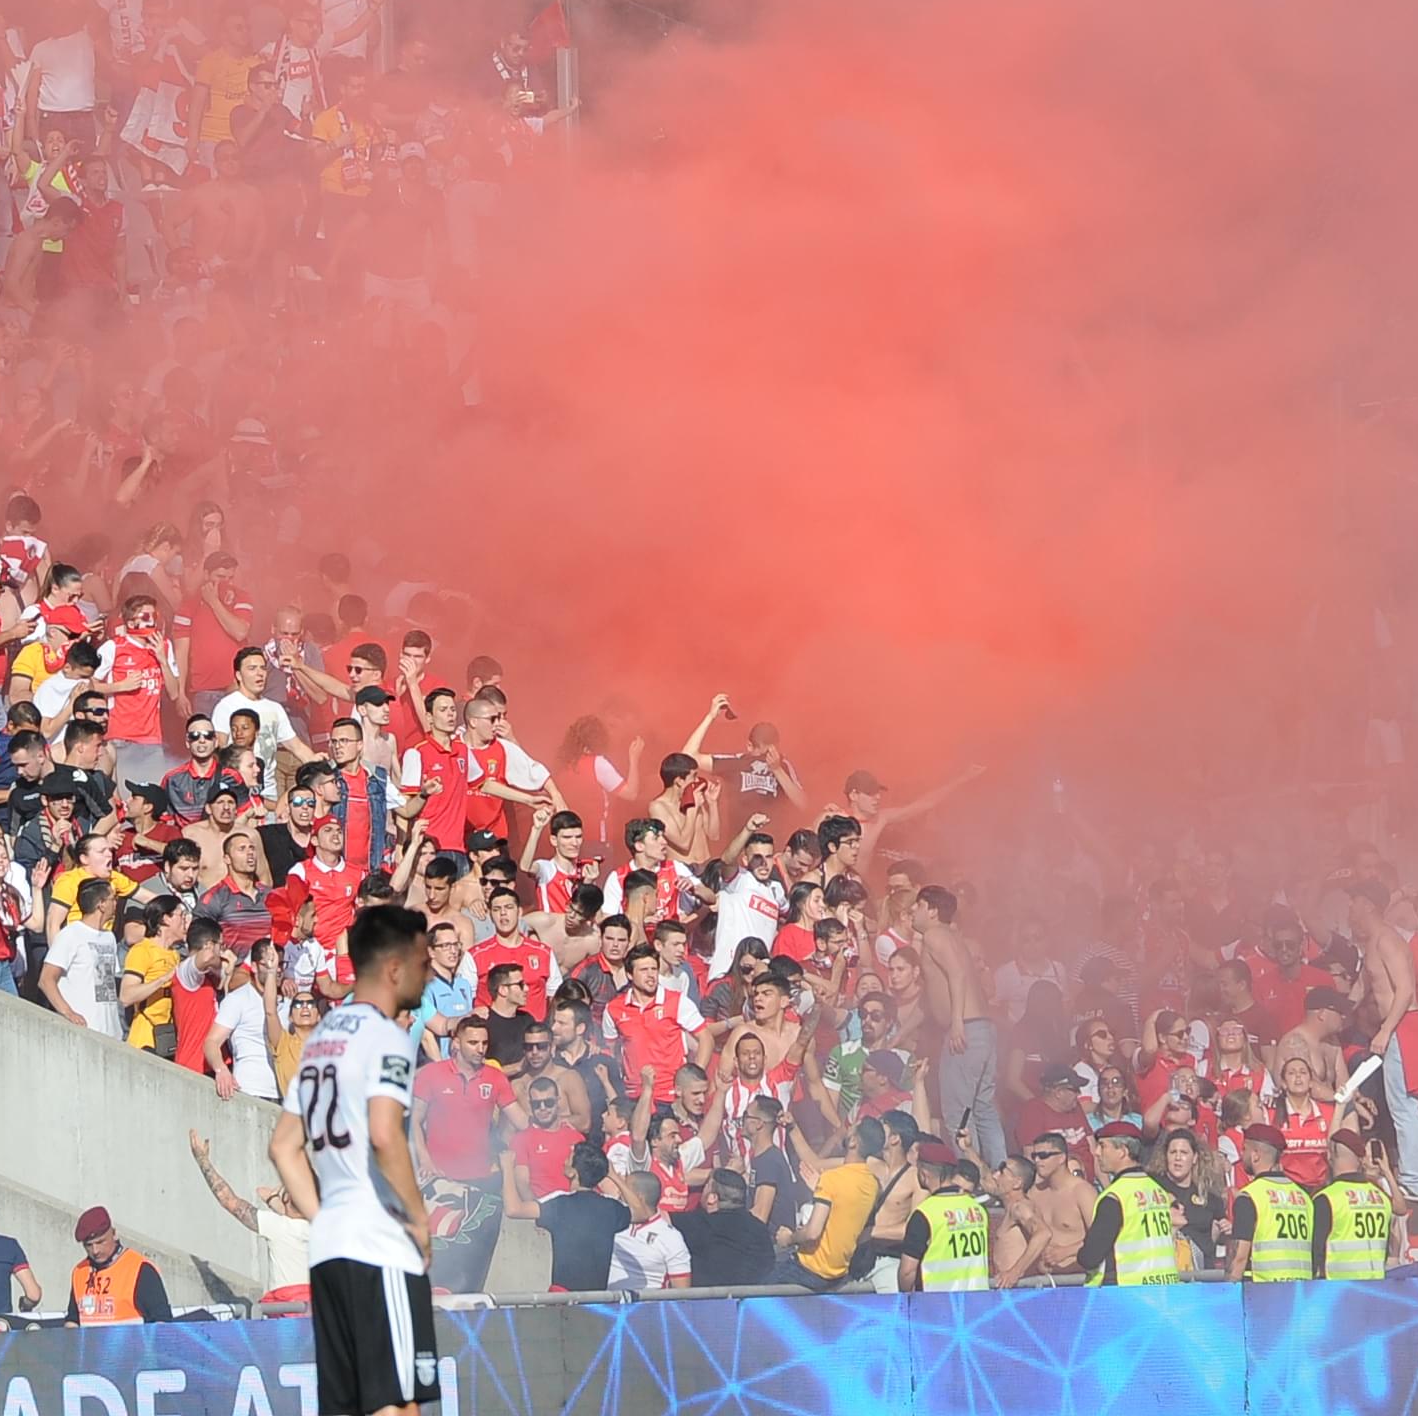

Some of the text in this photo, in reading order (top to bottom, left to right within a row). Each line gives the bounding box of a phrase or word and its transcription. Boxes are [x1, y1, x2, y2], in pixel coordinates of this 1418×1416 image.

[299, 1063, 353, 1151] 22
[1275, 1212, 1309, 1240] 206
[1354, 1212, 1386, 1239] 502
